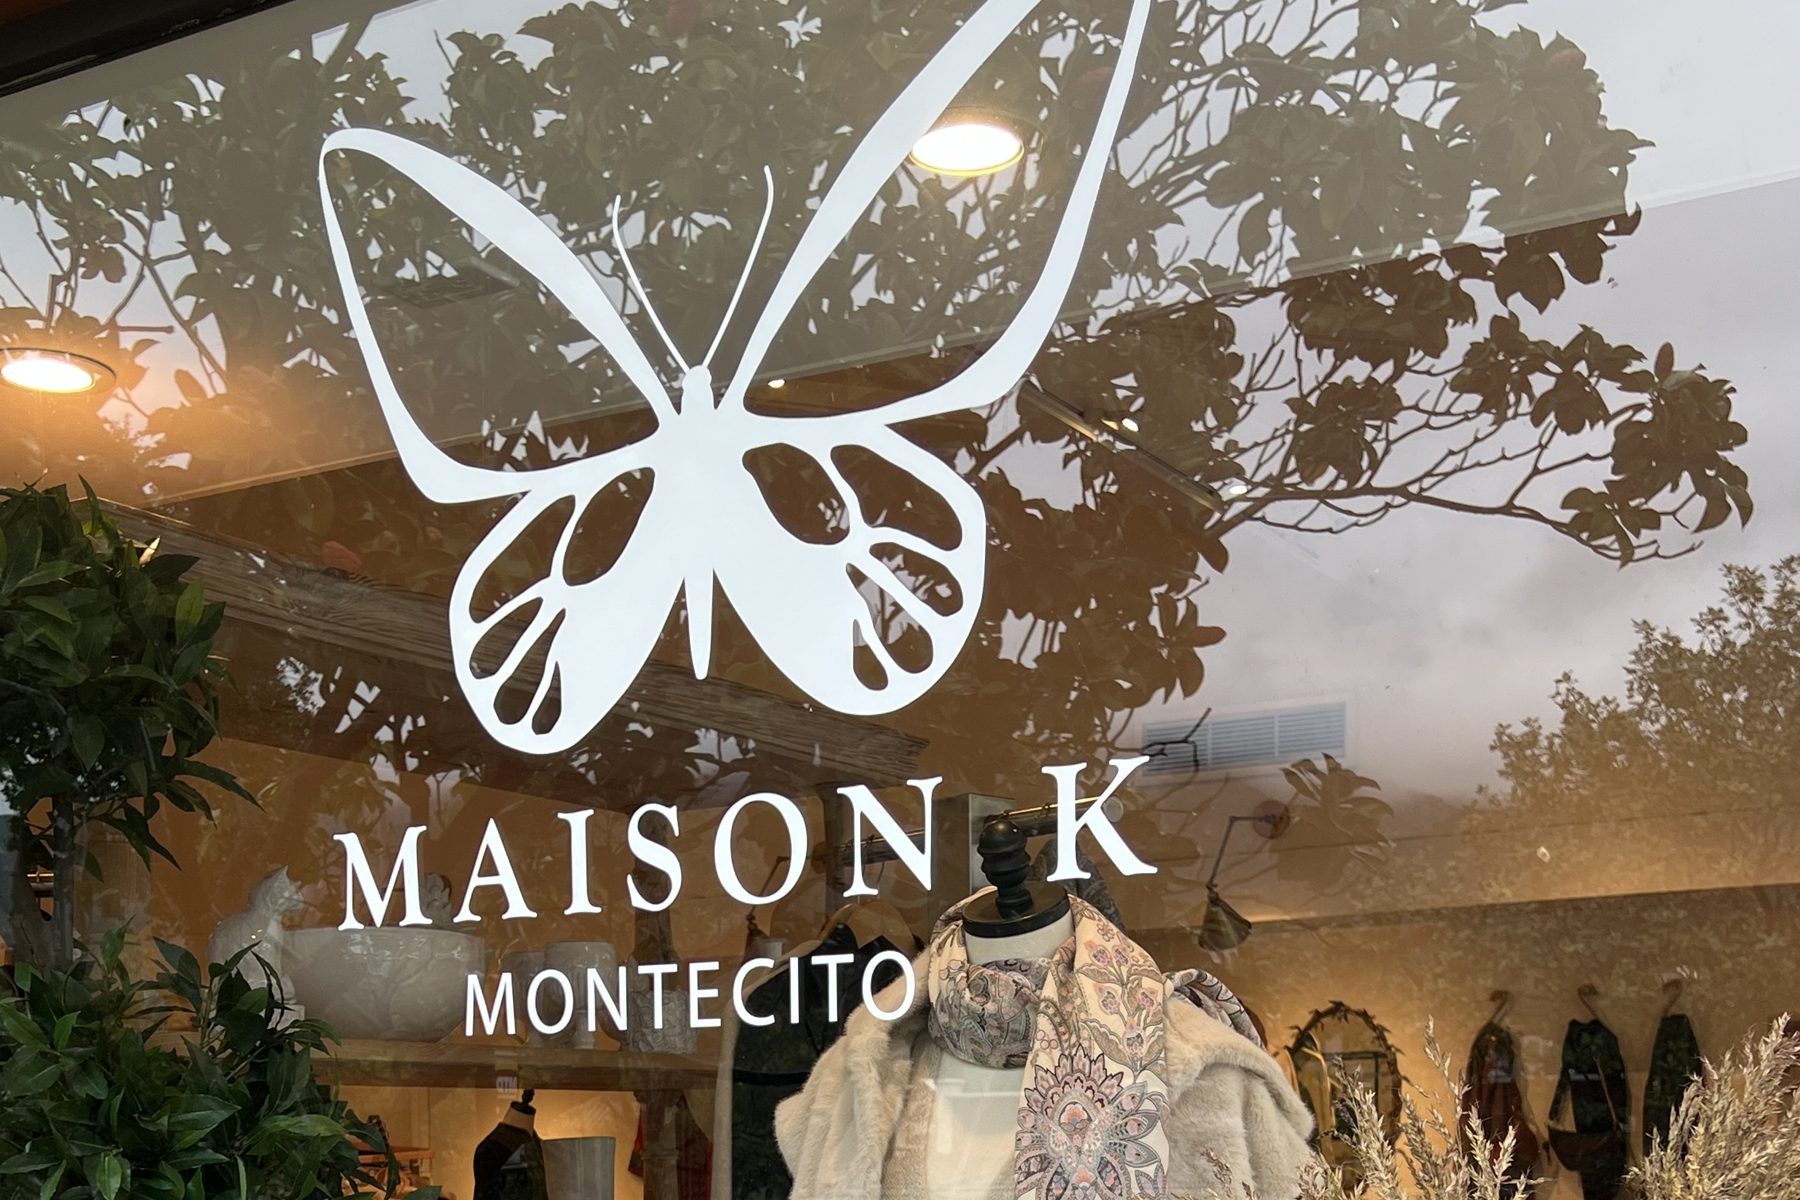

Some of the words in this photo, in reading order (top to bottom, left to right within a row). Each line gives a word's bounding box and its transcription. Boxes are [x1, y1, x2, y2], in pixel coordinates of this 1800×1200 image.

[333, 776, 943, 931] MAISON
[1041, 755, 1158, 882] K
[465, 950, 916, 1036] MONTECITO
